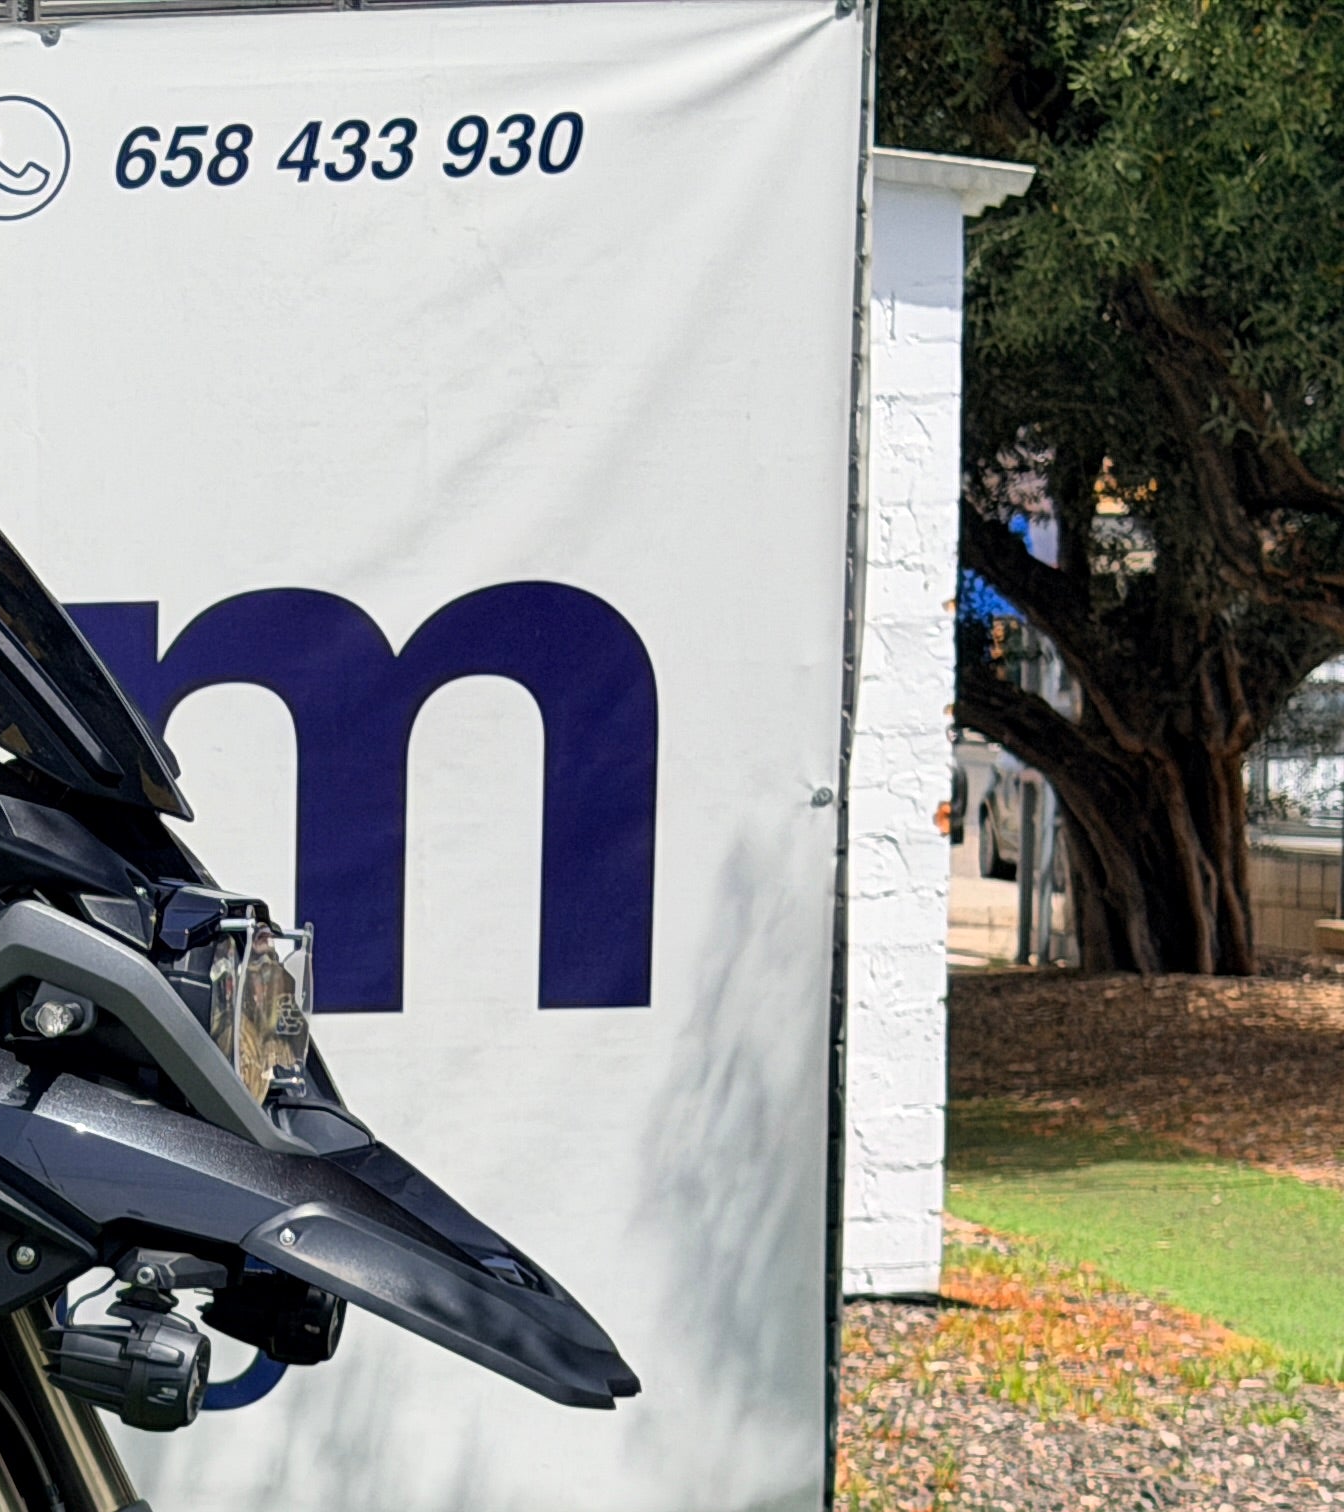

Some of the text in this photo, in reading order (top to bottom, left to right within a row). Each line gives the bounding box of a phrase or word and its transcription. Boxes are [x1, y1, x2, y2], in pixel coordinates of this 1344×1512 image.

[114, 110, 585, 191] 658 433 930
